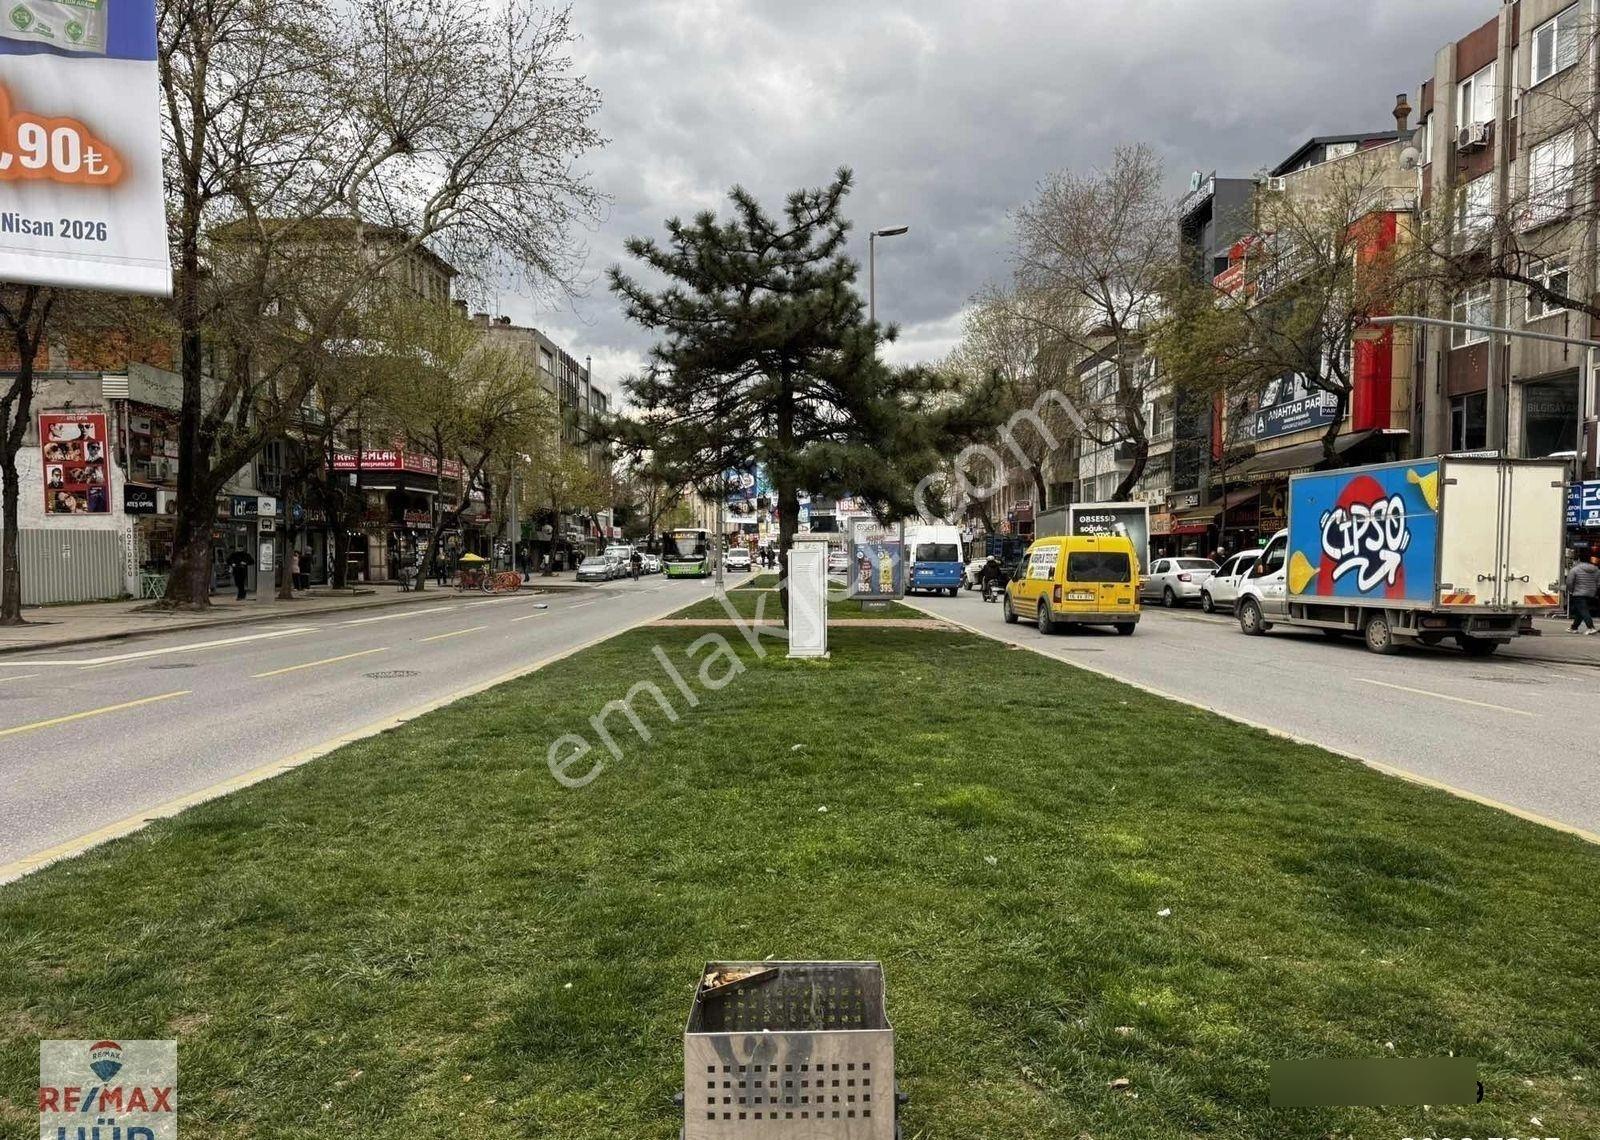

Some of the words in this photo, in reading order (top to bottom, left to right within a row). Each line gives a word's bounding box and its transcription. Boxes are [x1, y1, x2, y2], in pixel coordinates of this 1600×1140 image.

[1, 212, 54, 237] Nisan
[60, 218, 107, 242] 2026
[1268, 402, 1302, 421] ANAHTAR
[1305, 397, 1321, 410] PAR
[361, 451, 397, 461] EMLAK
